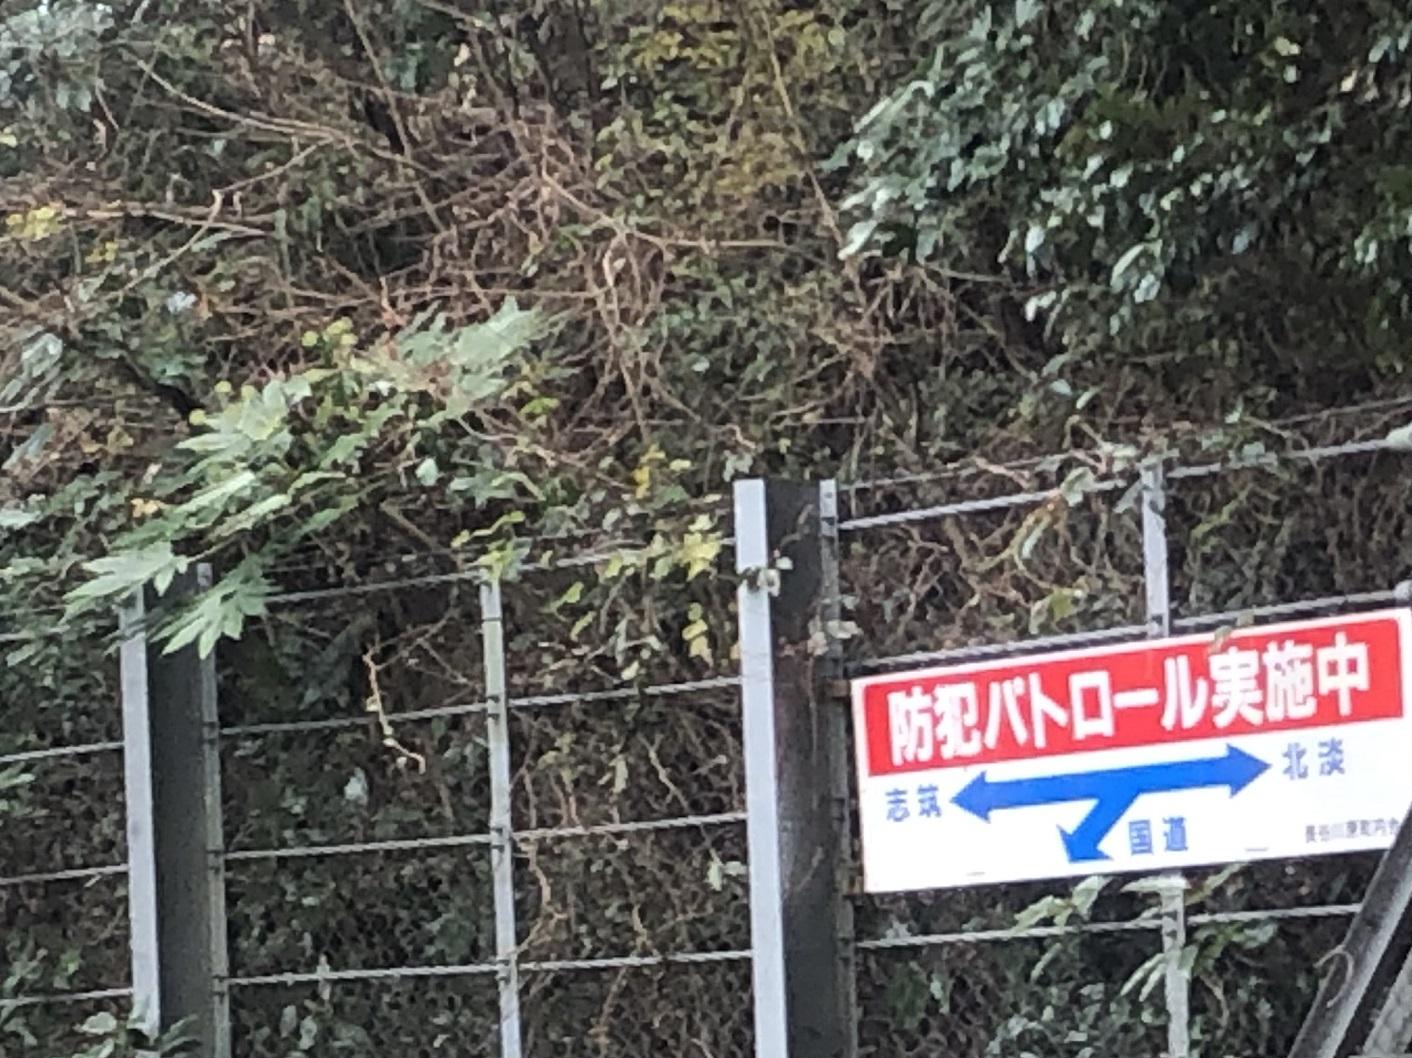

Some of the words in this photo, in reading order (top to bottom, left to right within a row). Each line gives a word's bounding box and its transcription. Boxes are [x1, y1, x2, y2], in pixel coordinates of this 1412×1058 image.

[887, 631, 1370, 766] 防犯パトロール実施中
[1128, 816, 1188, 855] 国道
